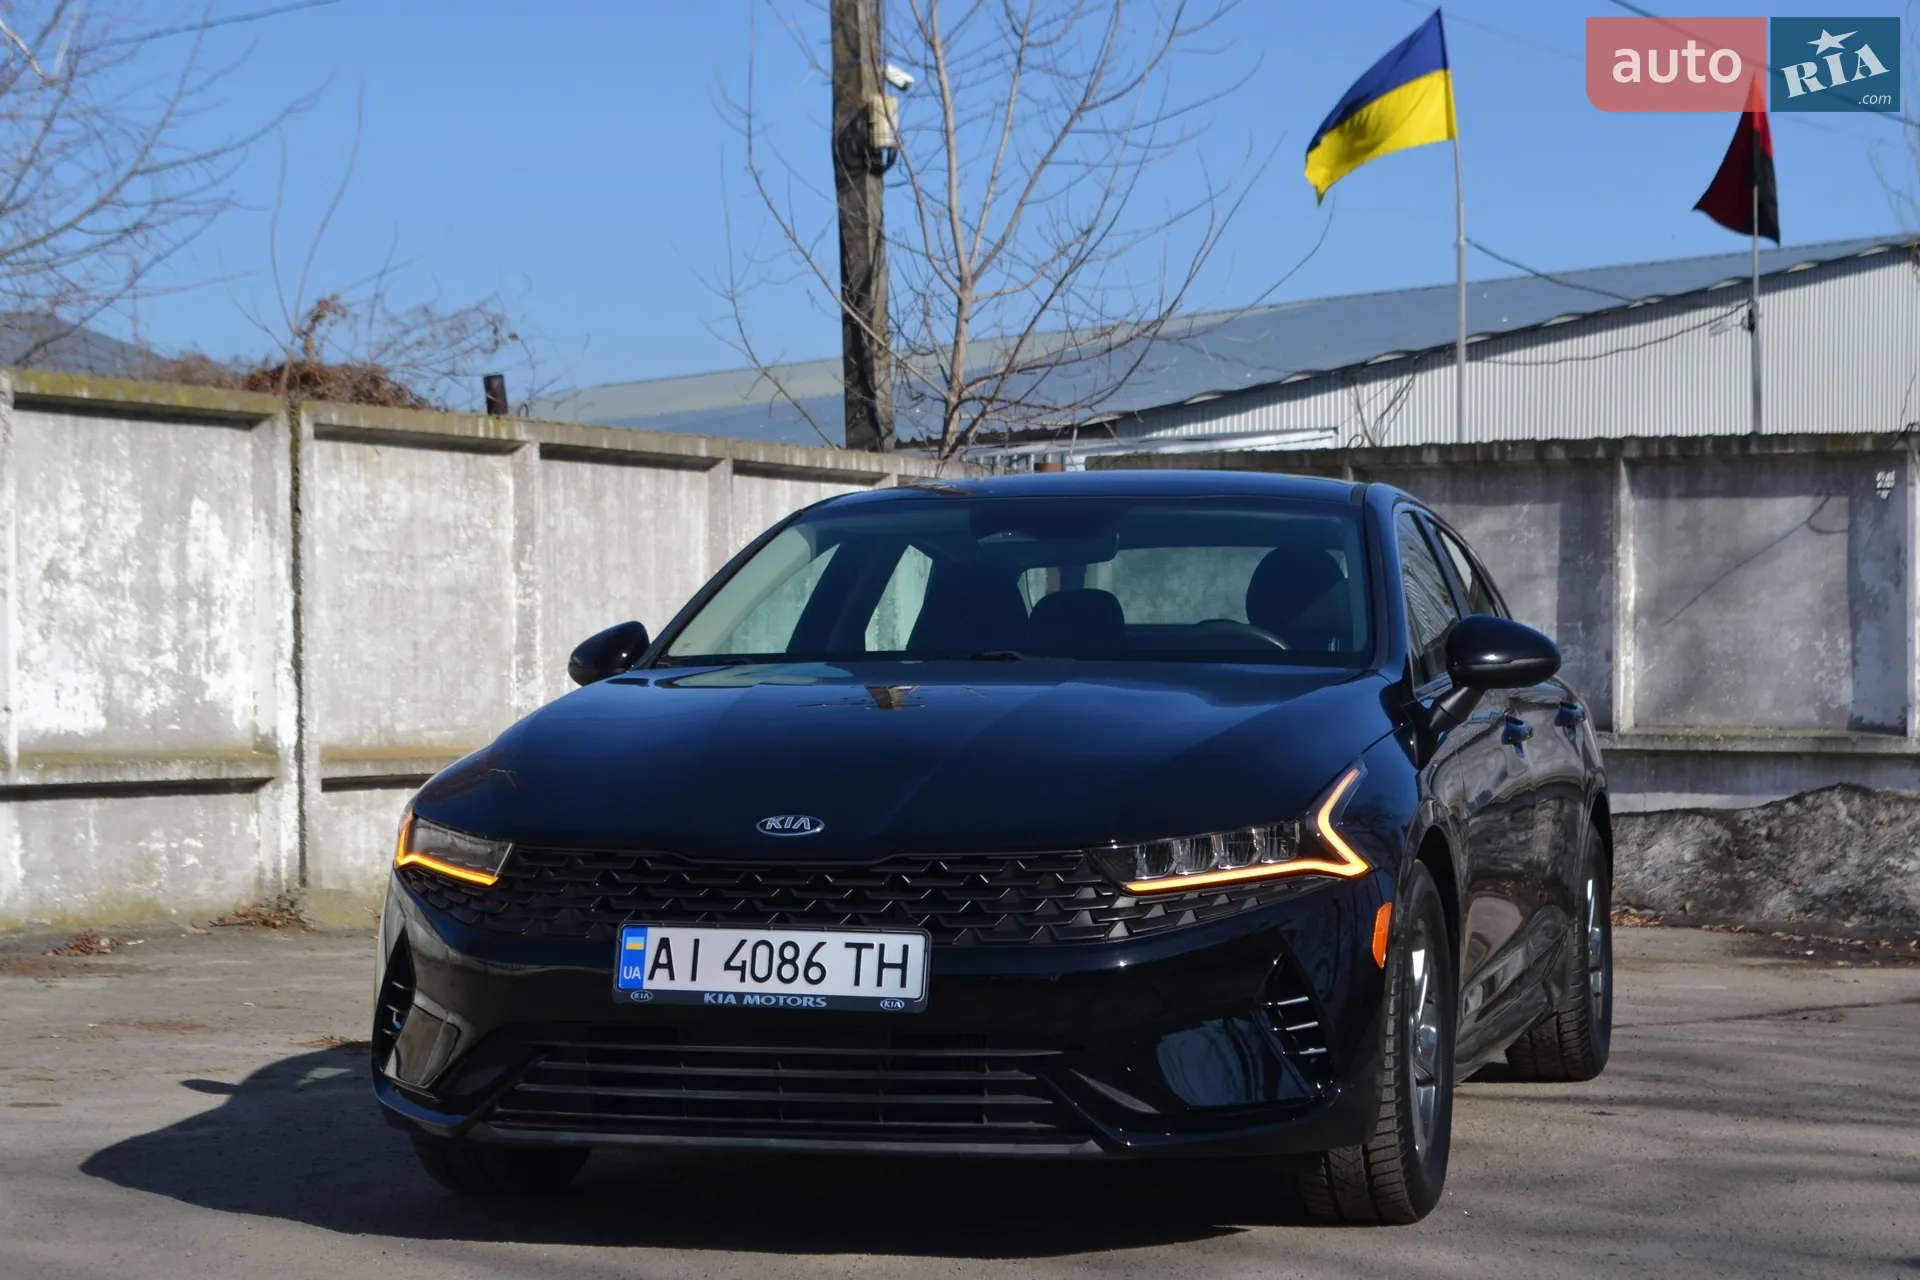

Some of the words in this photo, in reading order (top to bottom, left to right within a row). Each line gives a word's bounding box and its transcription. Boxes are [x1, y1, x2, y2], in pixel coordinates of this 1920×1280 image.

[766, 816, 810, 830] KIA
[648, 937, 700, 982] AI
[723, 939, 828, 985] 4086
[844, 942, 910, 988] TH
[623, 966, 641, 980] UA
[703, 992, 737, 1004] KIA
[743, 994, 827, 1007] MOTORS
